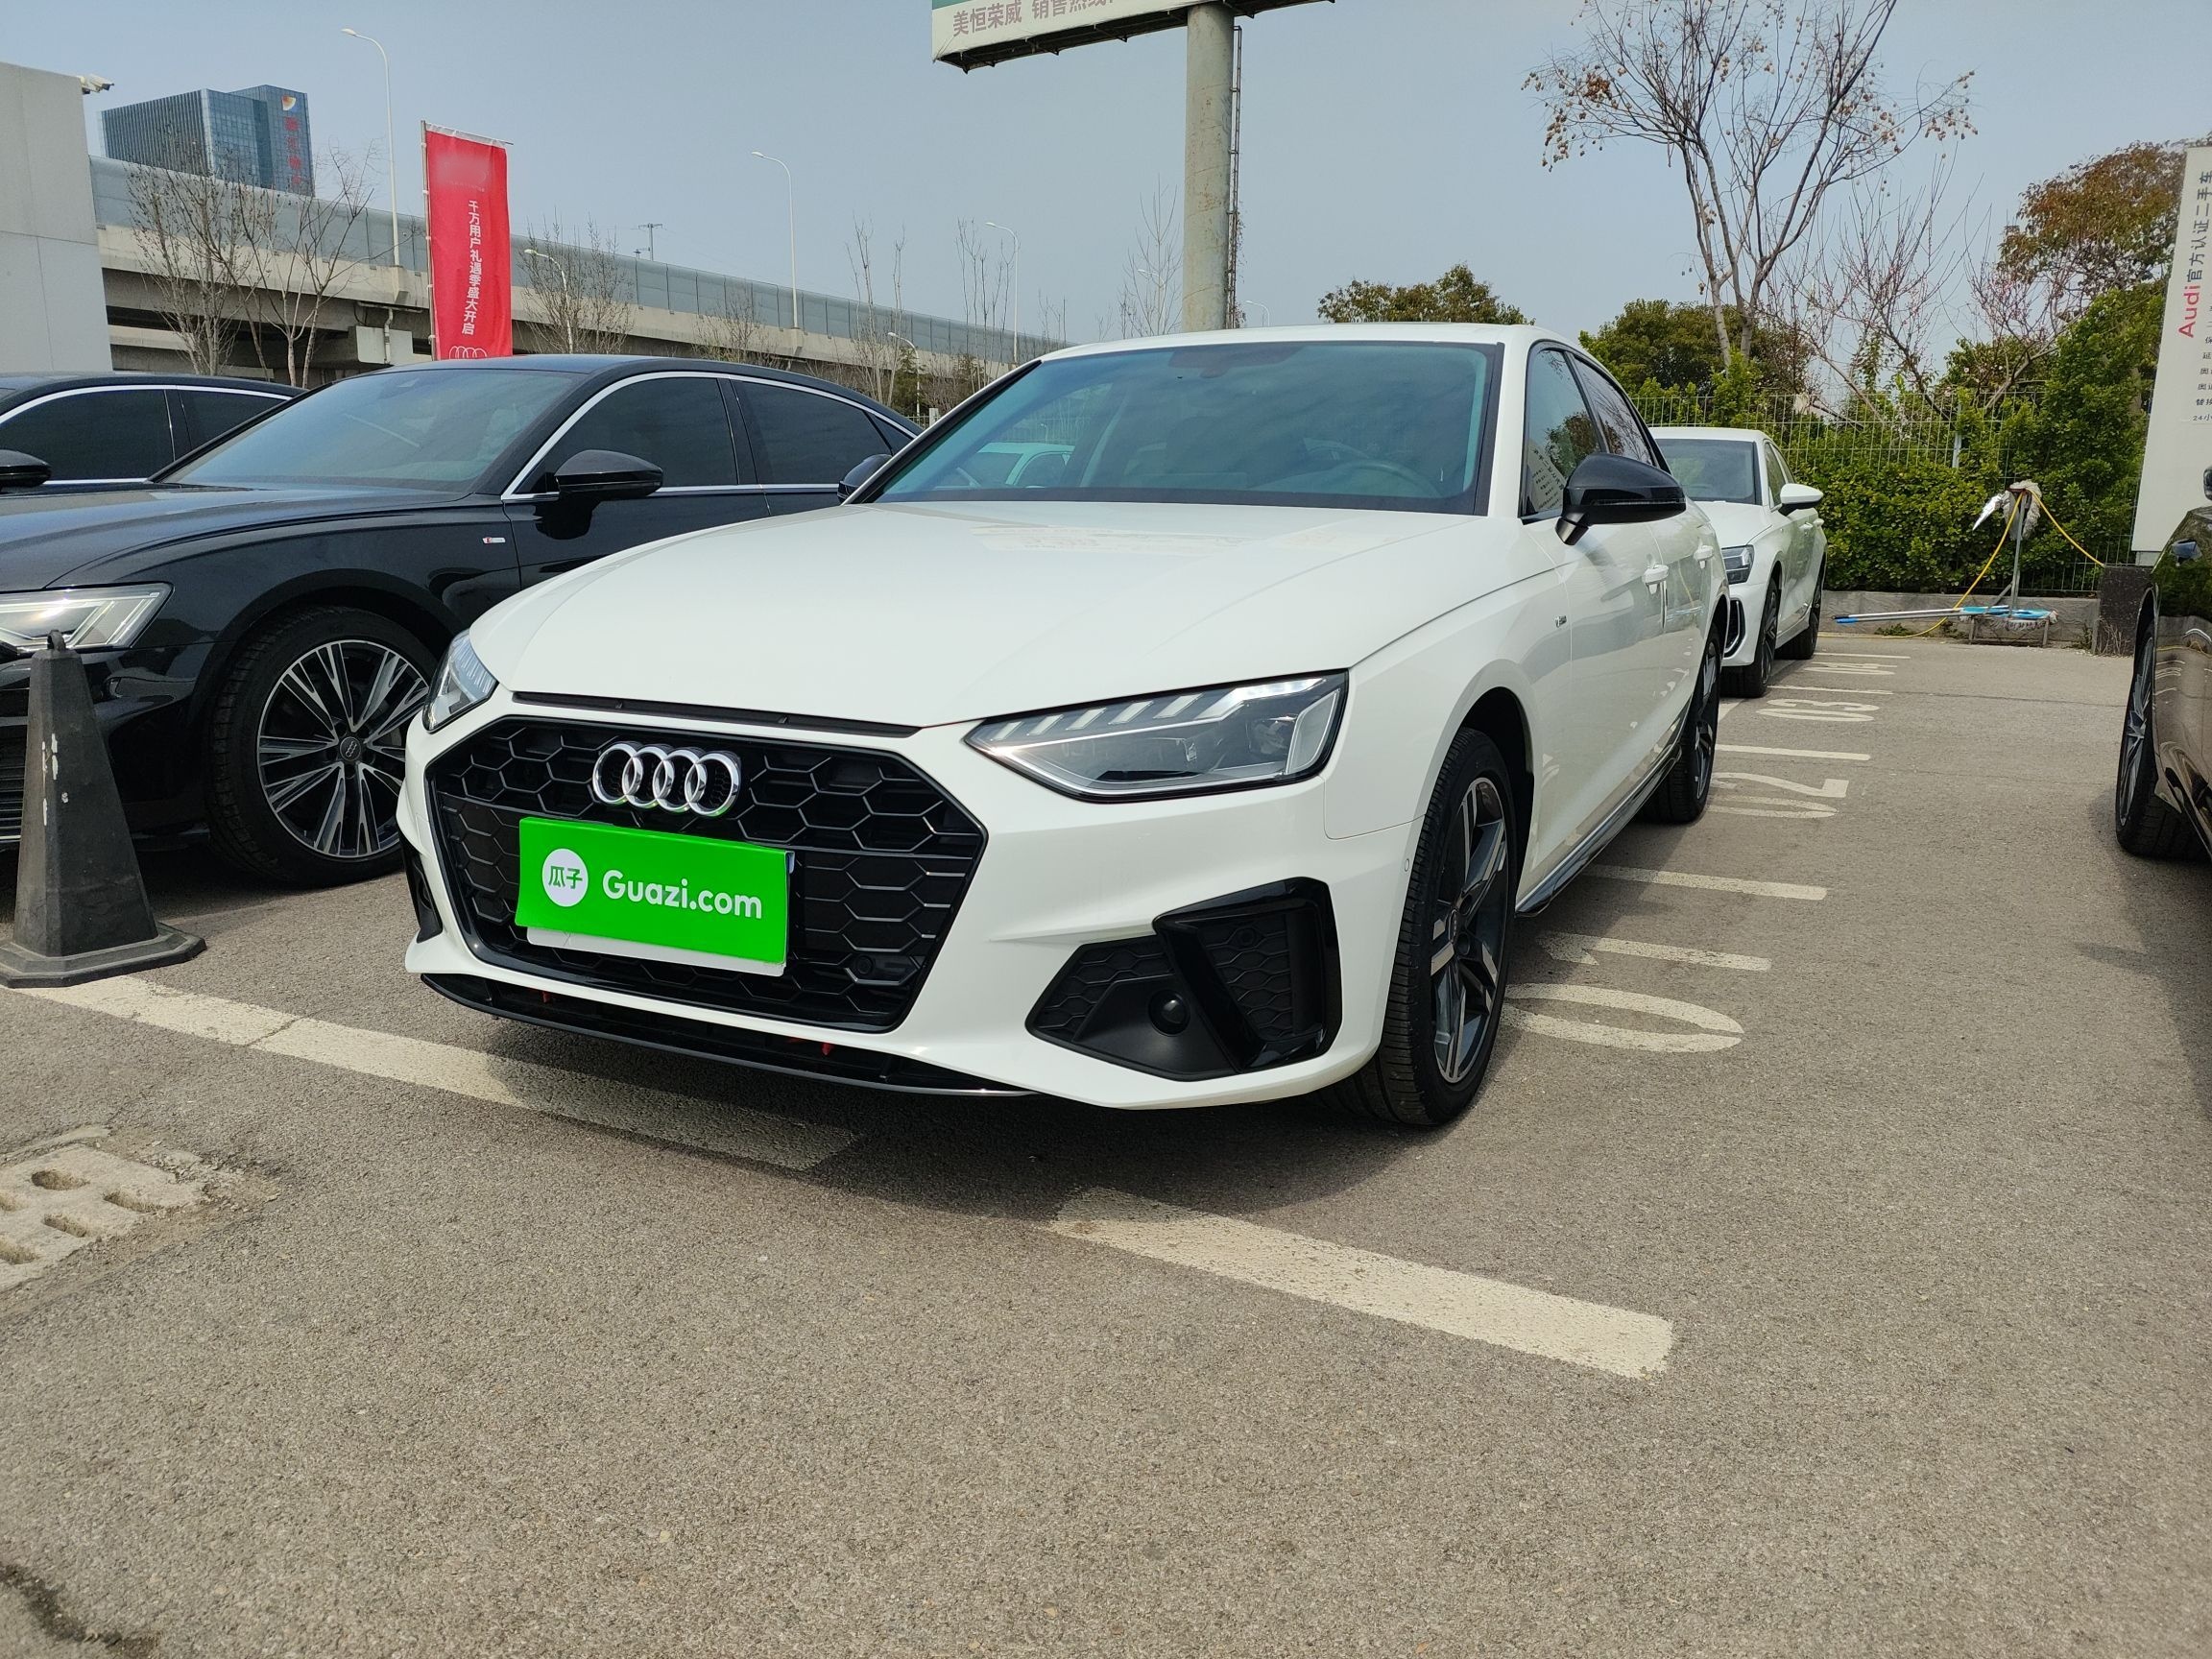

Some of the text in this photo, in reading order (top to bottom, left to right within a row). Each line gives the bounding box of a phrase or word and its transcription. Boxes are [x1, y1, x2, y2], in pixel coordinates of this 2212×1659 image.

[953, 0, 1022, 36] 美恒荣威
[461, 200, 483, 335] 千万用户礼遇季盛大开启
[2178, 170, 2212, 338] Audi 官方认证二手车
[1756, 699, 1880, 722] 03
[1705, 772, 1849, 818] 02
[548, 866, 583, 889] 瓜子
[603, 869, 762, 919] Guazi.com
[1500, 930, 1772, 1052] 01
